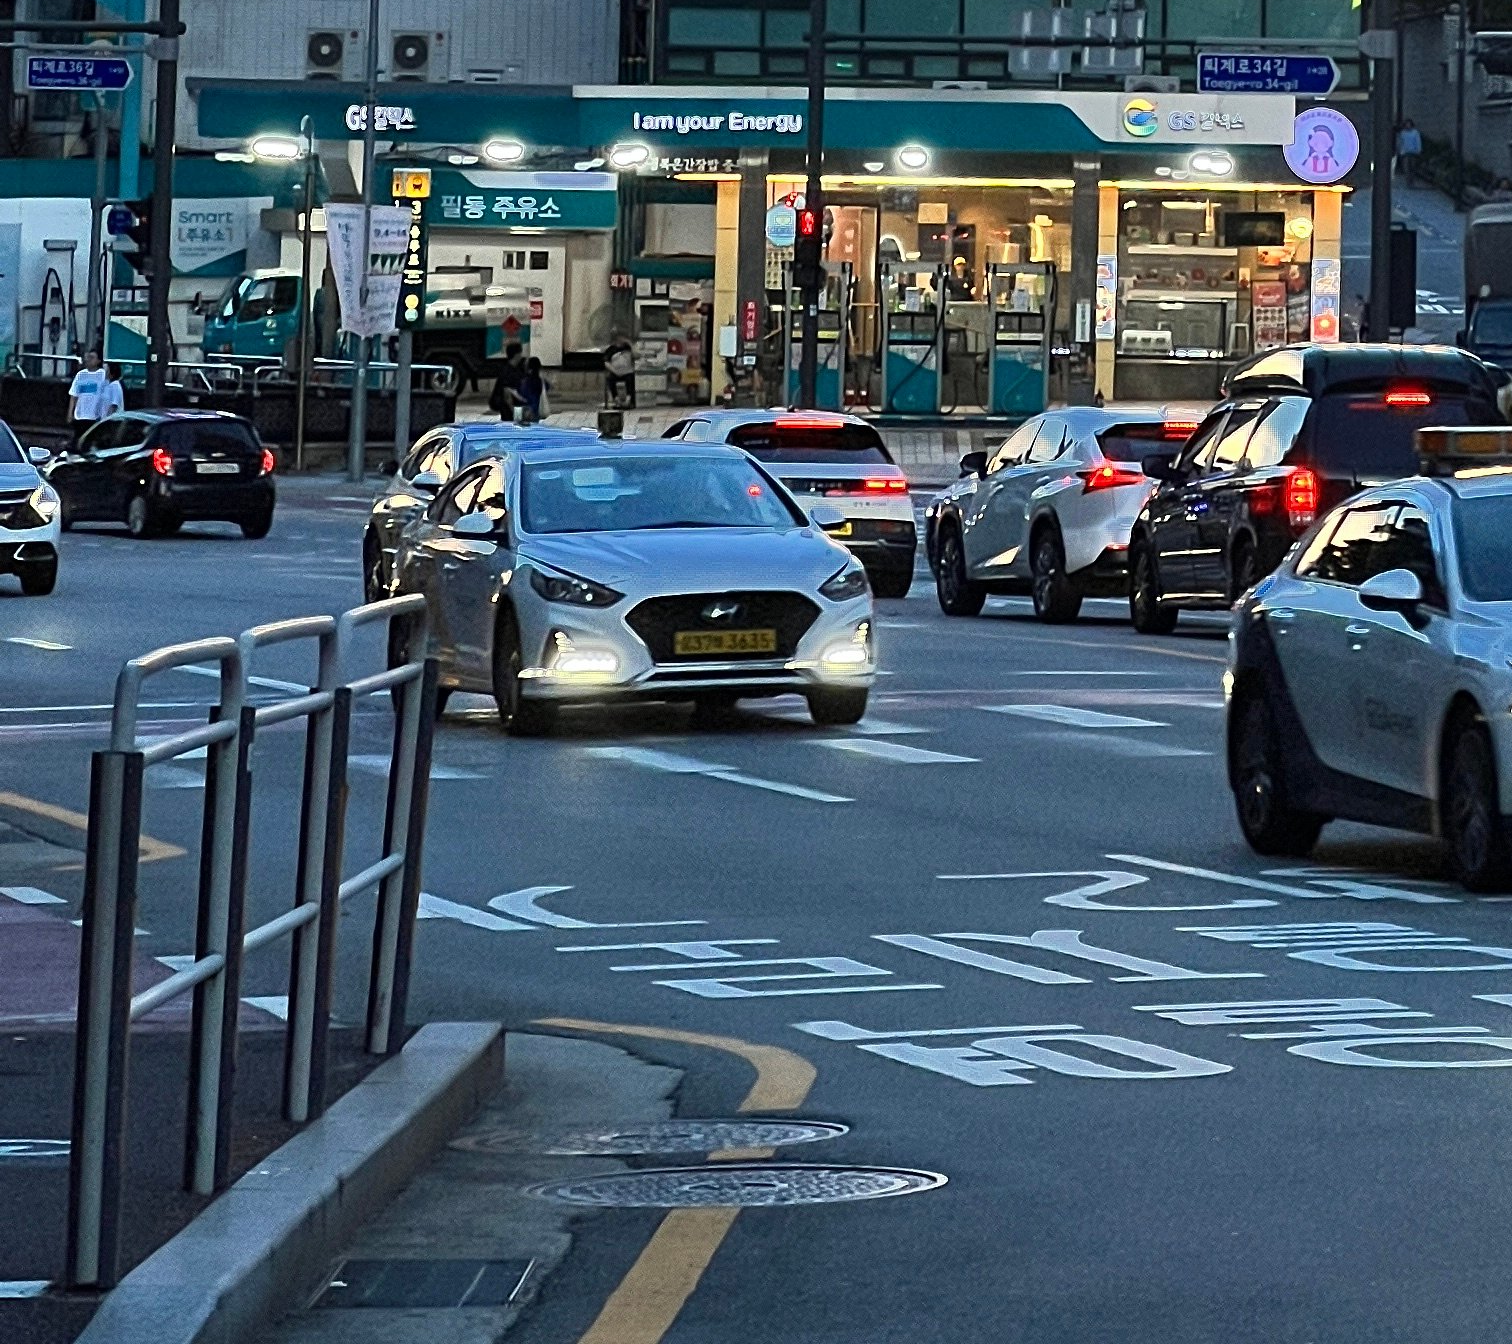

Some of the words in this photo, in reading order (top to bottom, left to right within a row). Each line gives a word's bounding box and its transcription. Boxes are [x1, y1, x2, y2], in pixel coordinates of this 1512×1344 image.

[1203, 58, 1287, 77] 퇴계로34길
[374, 107, 417, 131] 칼텍스
[633, 111, 640, 129] I
[641, 114, 674, 130] am
[675, 114, 725, 134] your
[728, 111, 803, 133] Energy
[1168, 111, 1197, 131] GS
[178, 211, 233, 224] Smart
[411, 200, 422, 215] 3
[441, 195, 487, 219] 필동
[492, 196, 562, 220] 주유소
